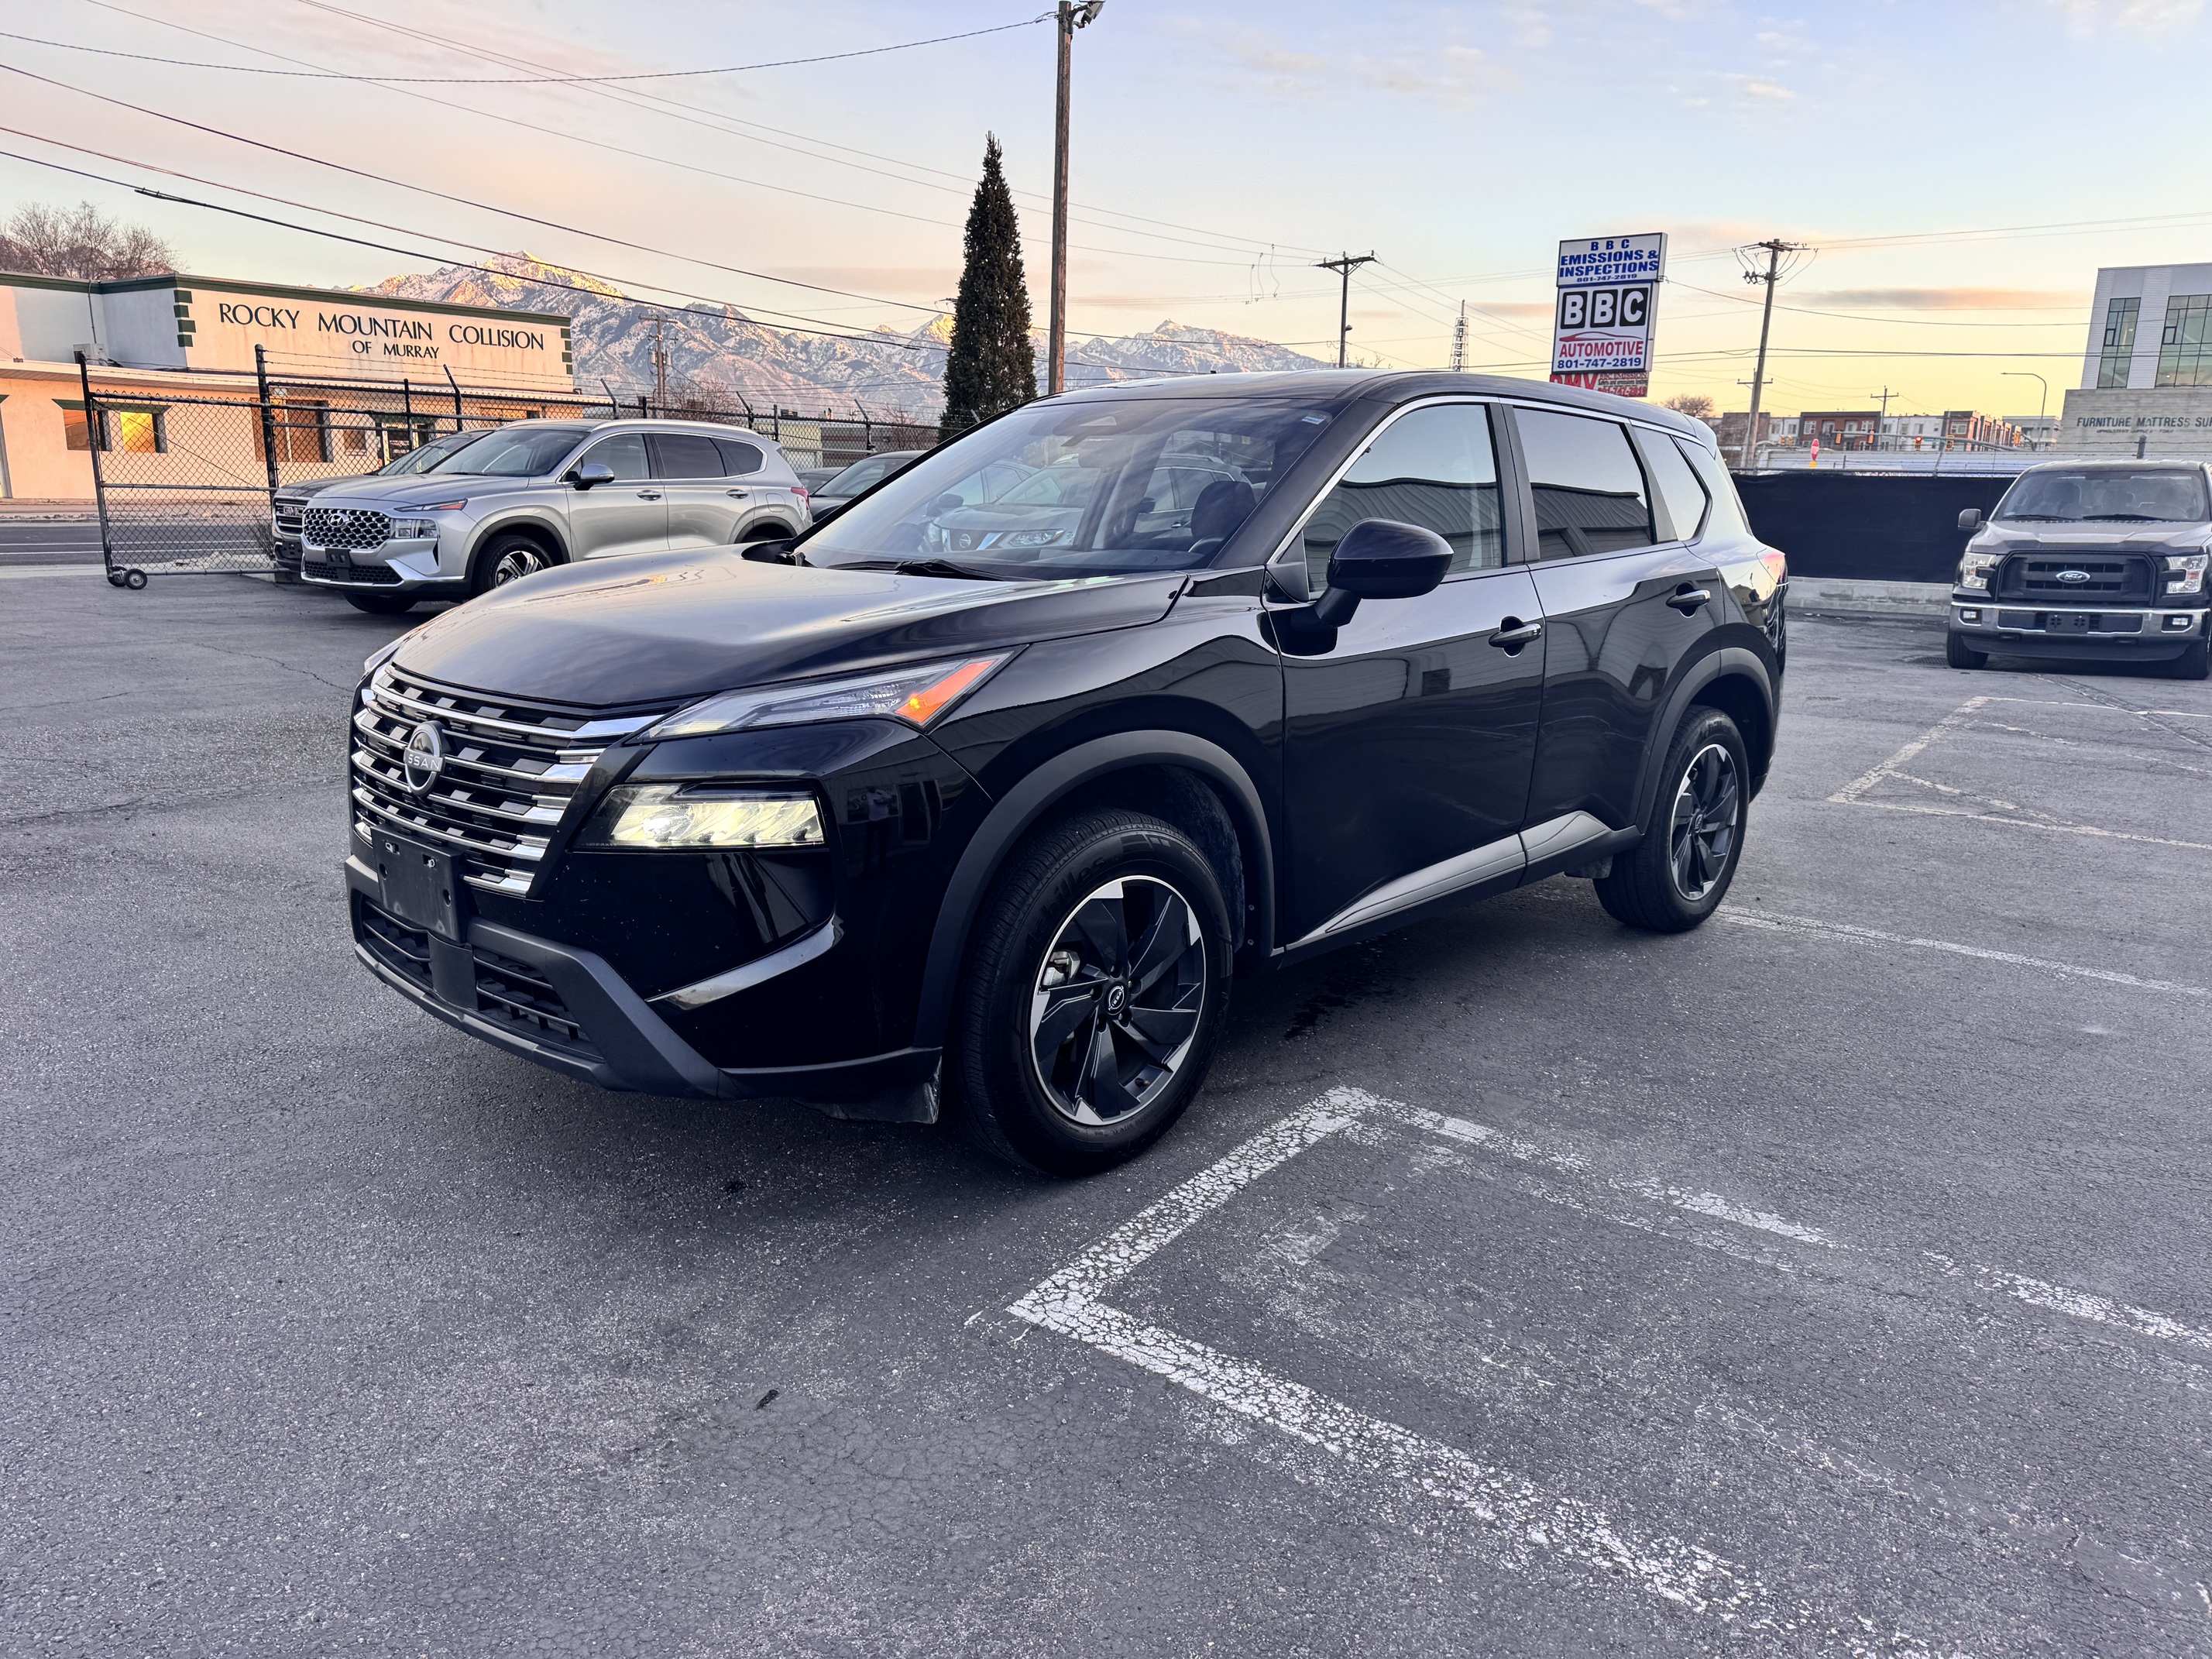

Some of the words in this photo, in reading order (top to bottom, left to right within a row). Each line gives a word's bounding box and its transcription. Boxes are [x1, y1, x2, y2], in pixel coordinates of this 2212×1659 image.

[1561, 249, 1644, 265] EMISSIONS
[1647, 250, 1659, 259] &
[1559, 260, 1659, 277] INSPECTIONS
[1576, 273, 1637, 283] 801-747-2819
[1564, 290, 1645, 325] BBC
[219, 303, 300, 329] ROCKY
[318, 313, 433, 341] MOUNTAIN
[448, 325, 544, 351] COLLISION
[352, 340, 372, 354] OF
[383, 343, 439, 359] MURRAY
[1559, 341, 1644, 358] AUTOMOTIVE
[1558, 357, 1641, 369] 801-747-2819
[2076, 417, 2131, 428] FURNITURE
[2136, 417, 2190, 428] MATTRESS
[283, 506, 304, 516] GMC
[407, 754, 441, 770] SSAN
